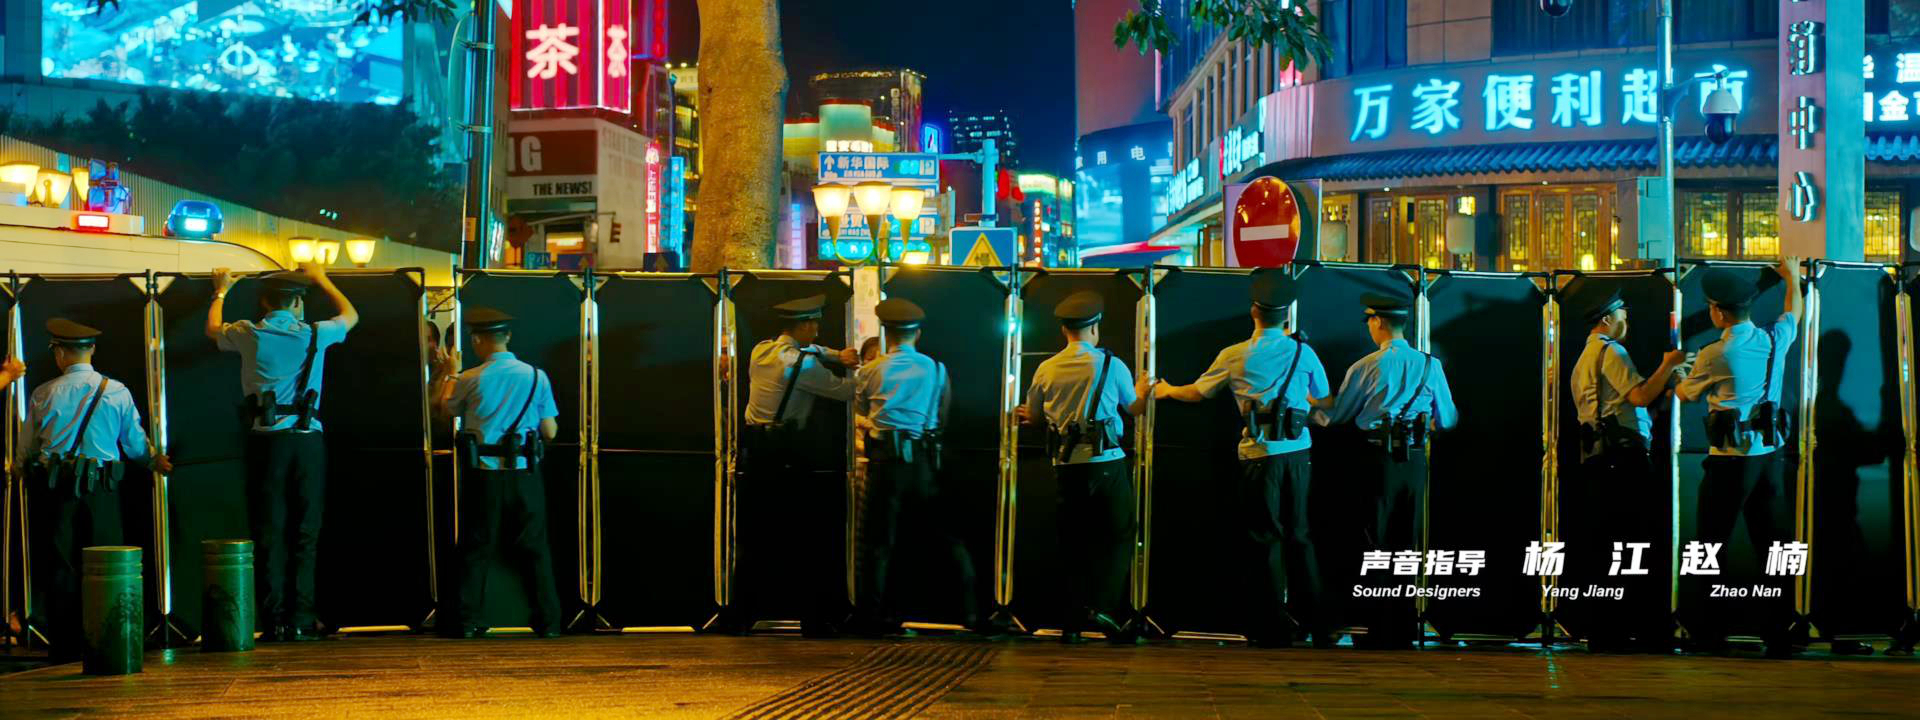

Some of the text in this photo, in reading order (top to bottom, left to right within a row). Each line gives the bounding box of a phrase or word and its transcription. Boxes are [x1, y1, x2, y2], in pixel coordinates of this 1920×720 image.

[525, 22, 580, 79] 茶
[1350, 64, 1748, 142] 万家便利超市
[837, 156, 890, 170] 新华国际
[532, 183, 552, 196] THE
